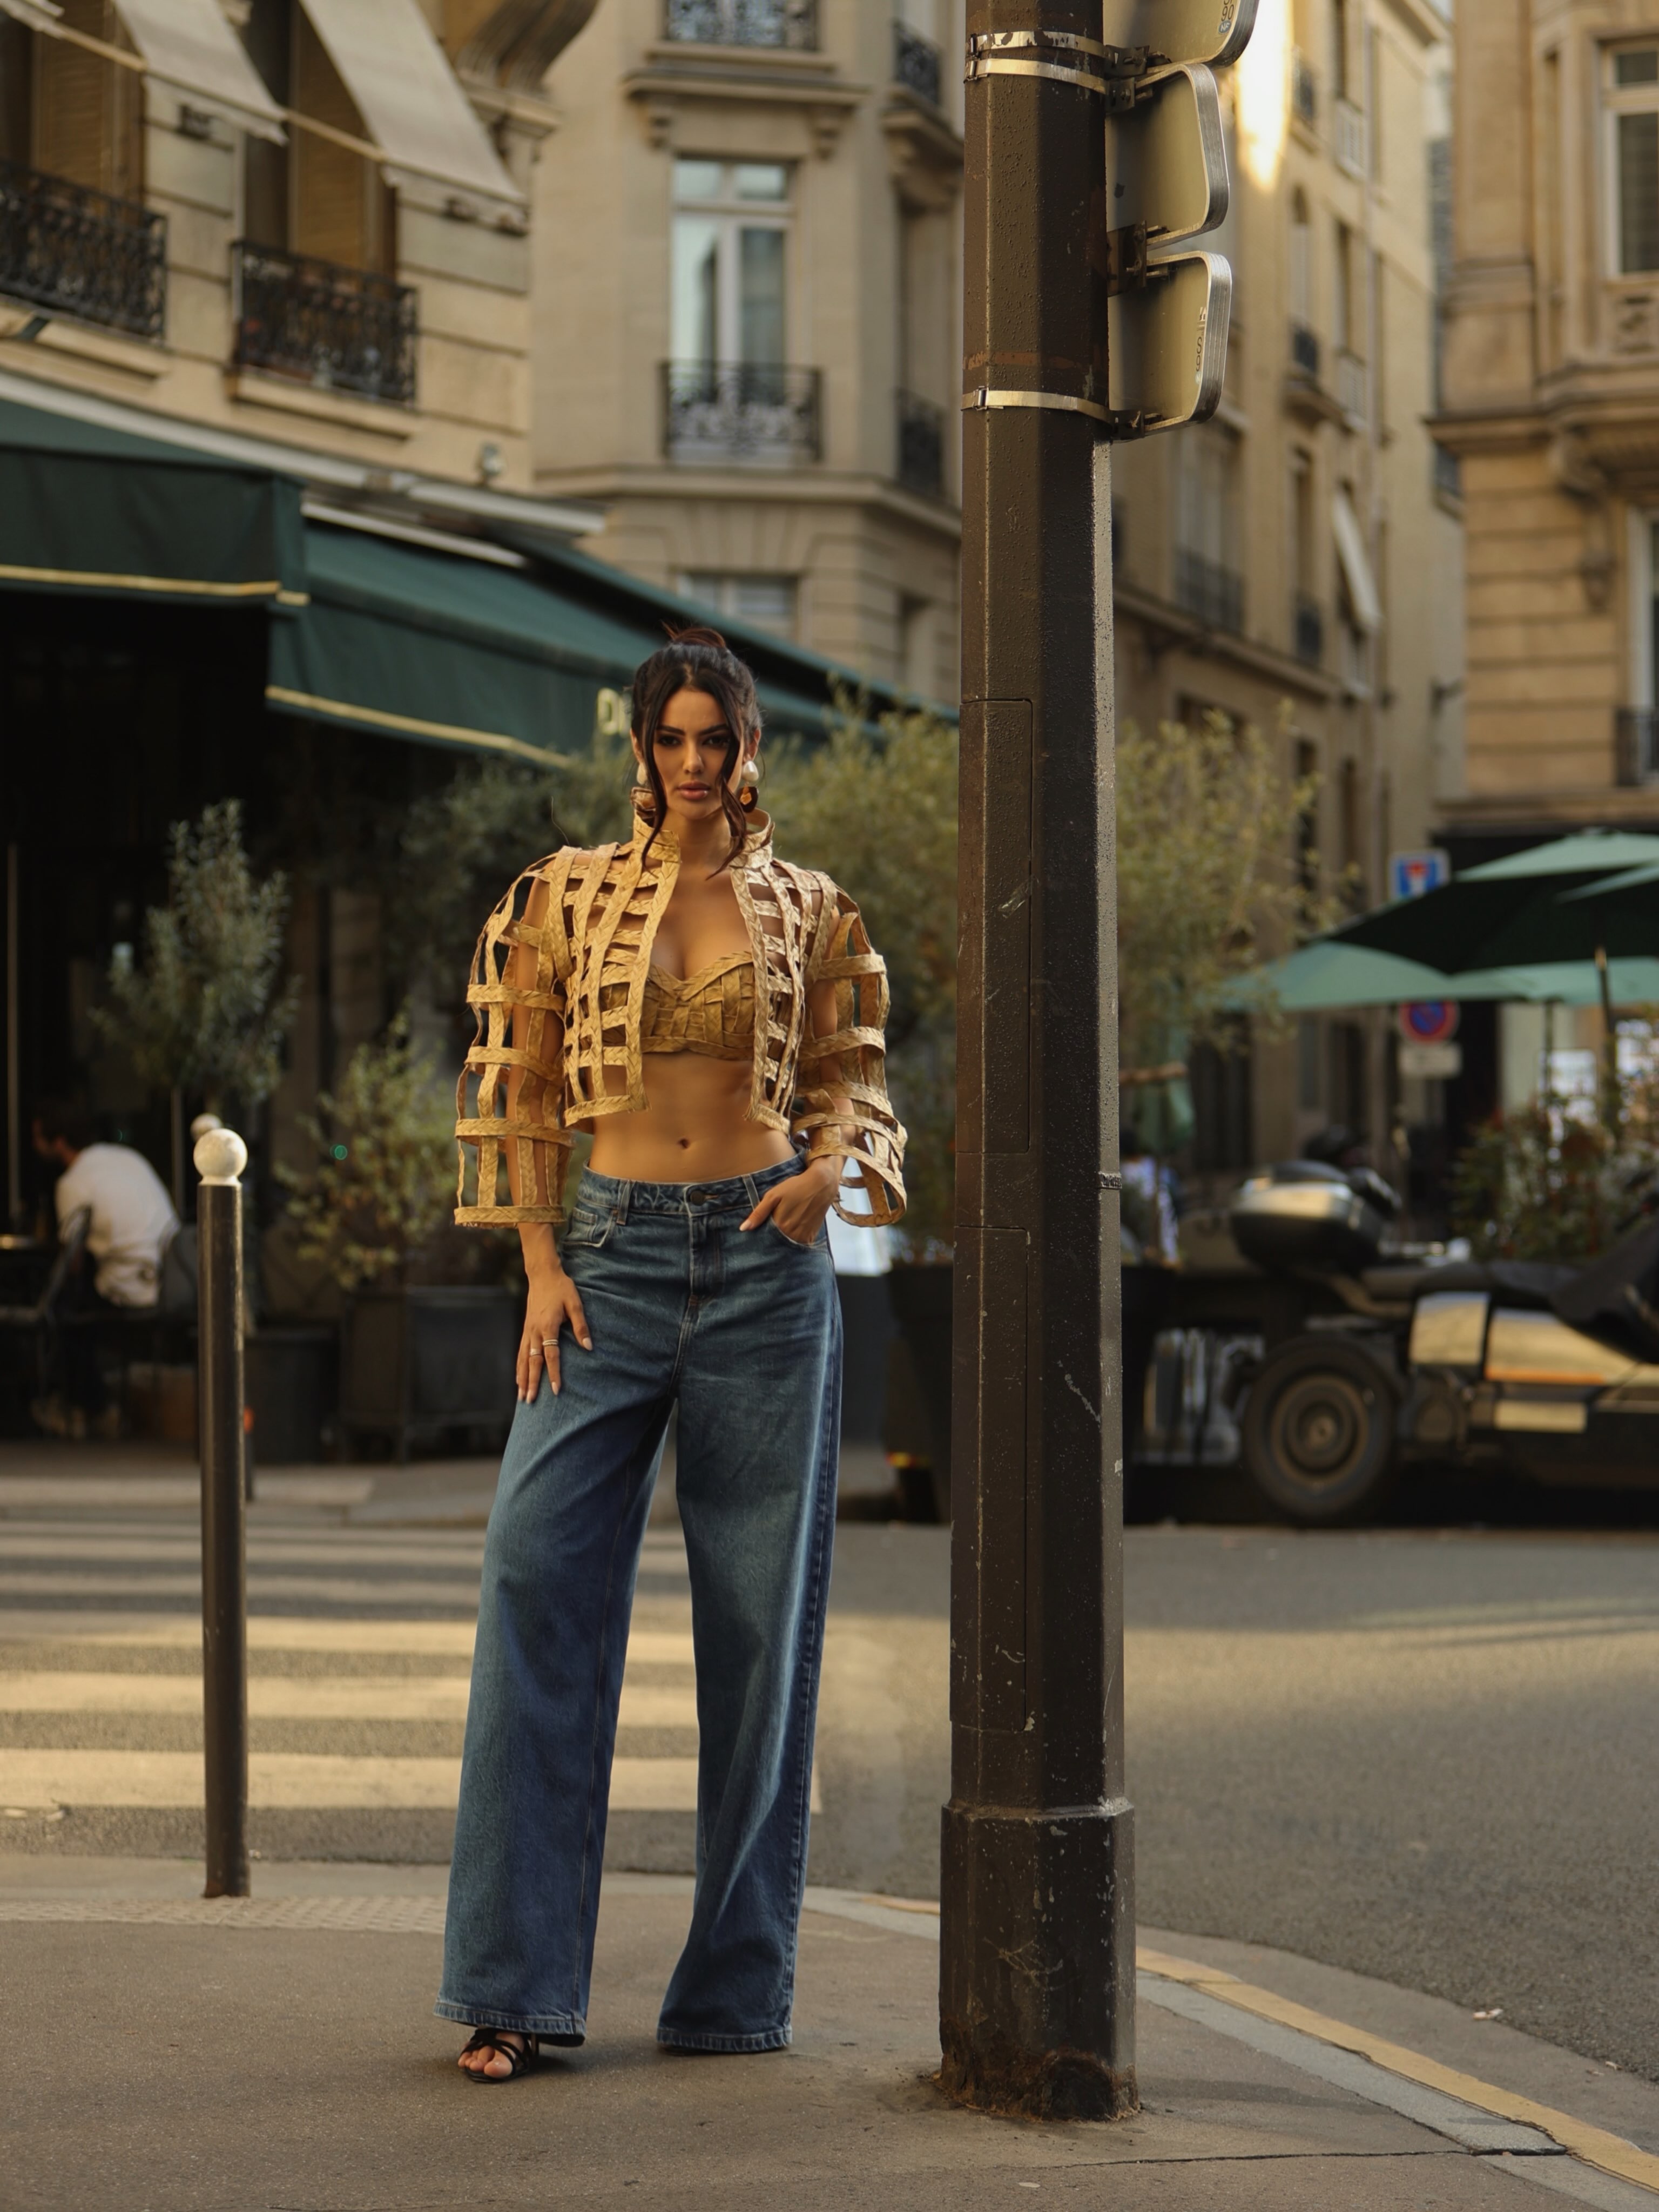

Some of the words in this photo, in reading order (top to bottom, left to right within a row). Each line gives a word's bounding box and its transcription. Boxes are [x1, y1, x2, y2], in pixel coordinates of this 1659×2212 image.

[1221, 4, 1234, 22] 90
[1220, 23, 1230, 32] NF
[1197, 336, 1202, 354] S
[1196, 355, 1201, 372] 9
